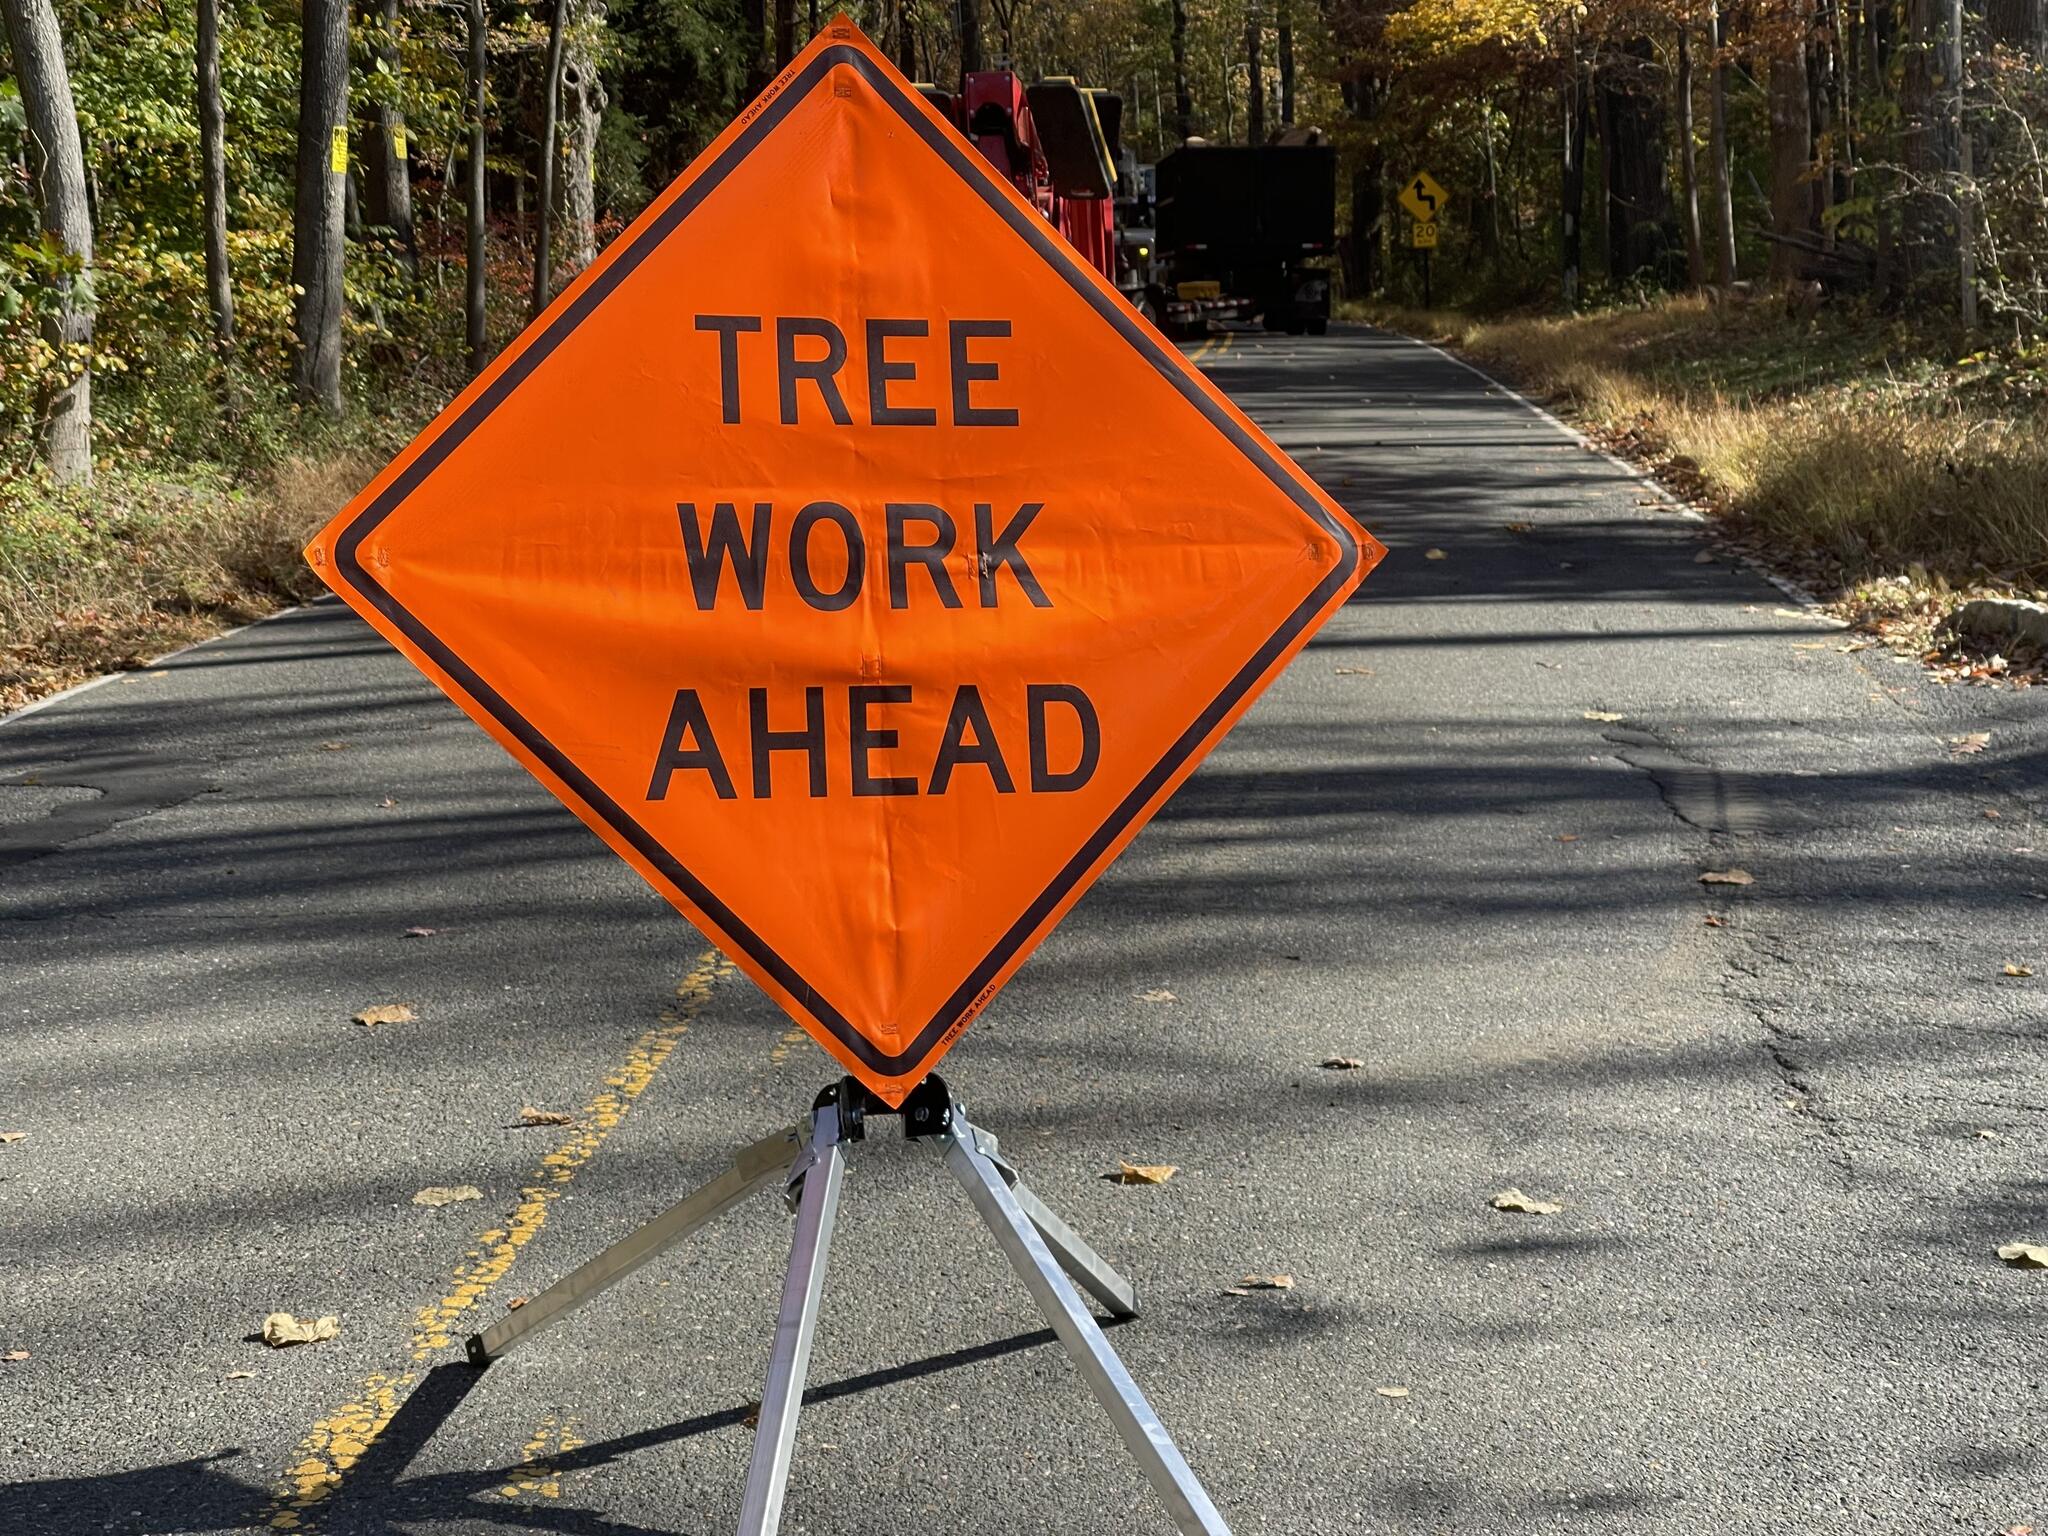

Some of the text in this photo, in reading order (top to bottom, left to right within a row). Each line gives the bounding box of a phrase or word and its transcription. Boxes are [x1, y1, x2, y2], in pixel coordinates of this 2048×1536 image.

[740, 69, 796, 125] TREE WORK AHEAD
[1415, 224, 1436, 238] 20
[694, 314, 1020, 427] TREE
[676, 501, 1055, 612] WORK
[645, 683, 1101, 801] AHEAD
[941, 984, 996, 1046] TREE WORK AHEAD
